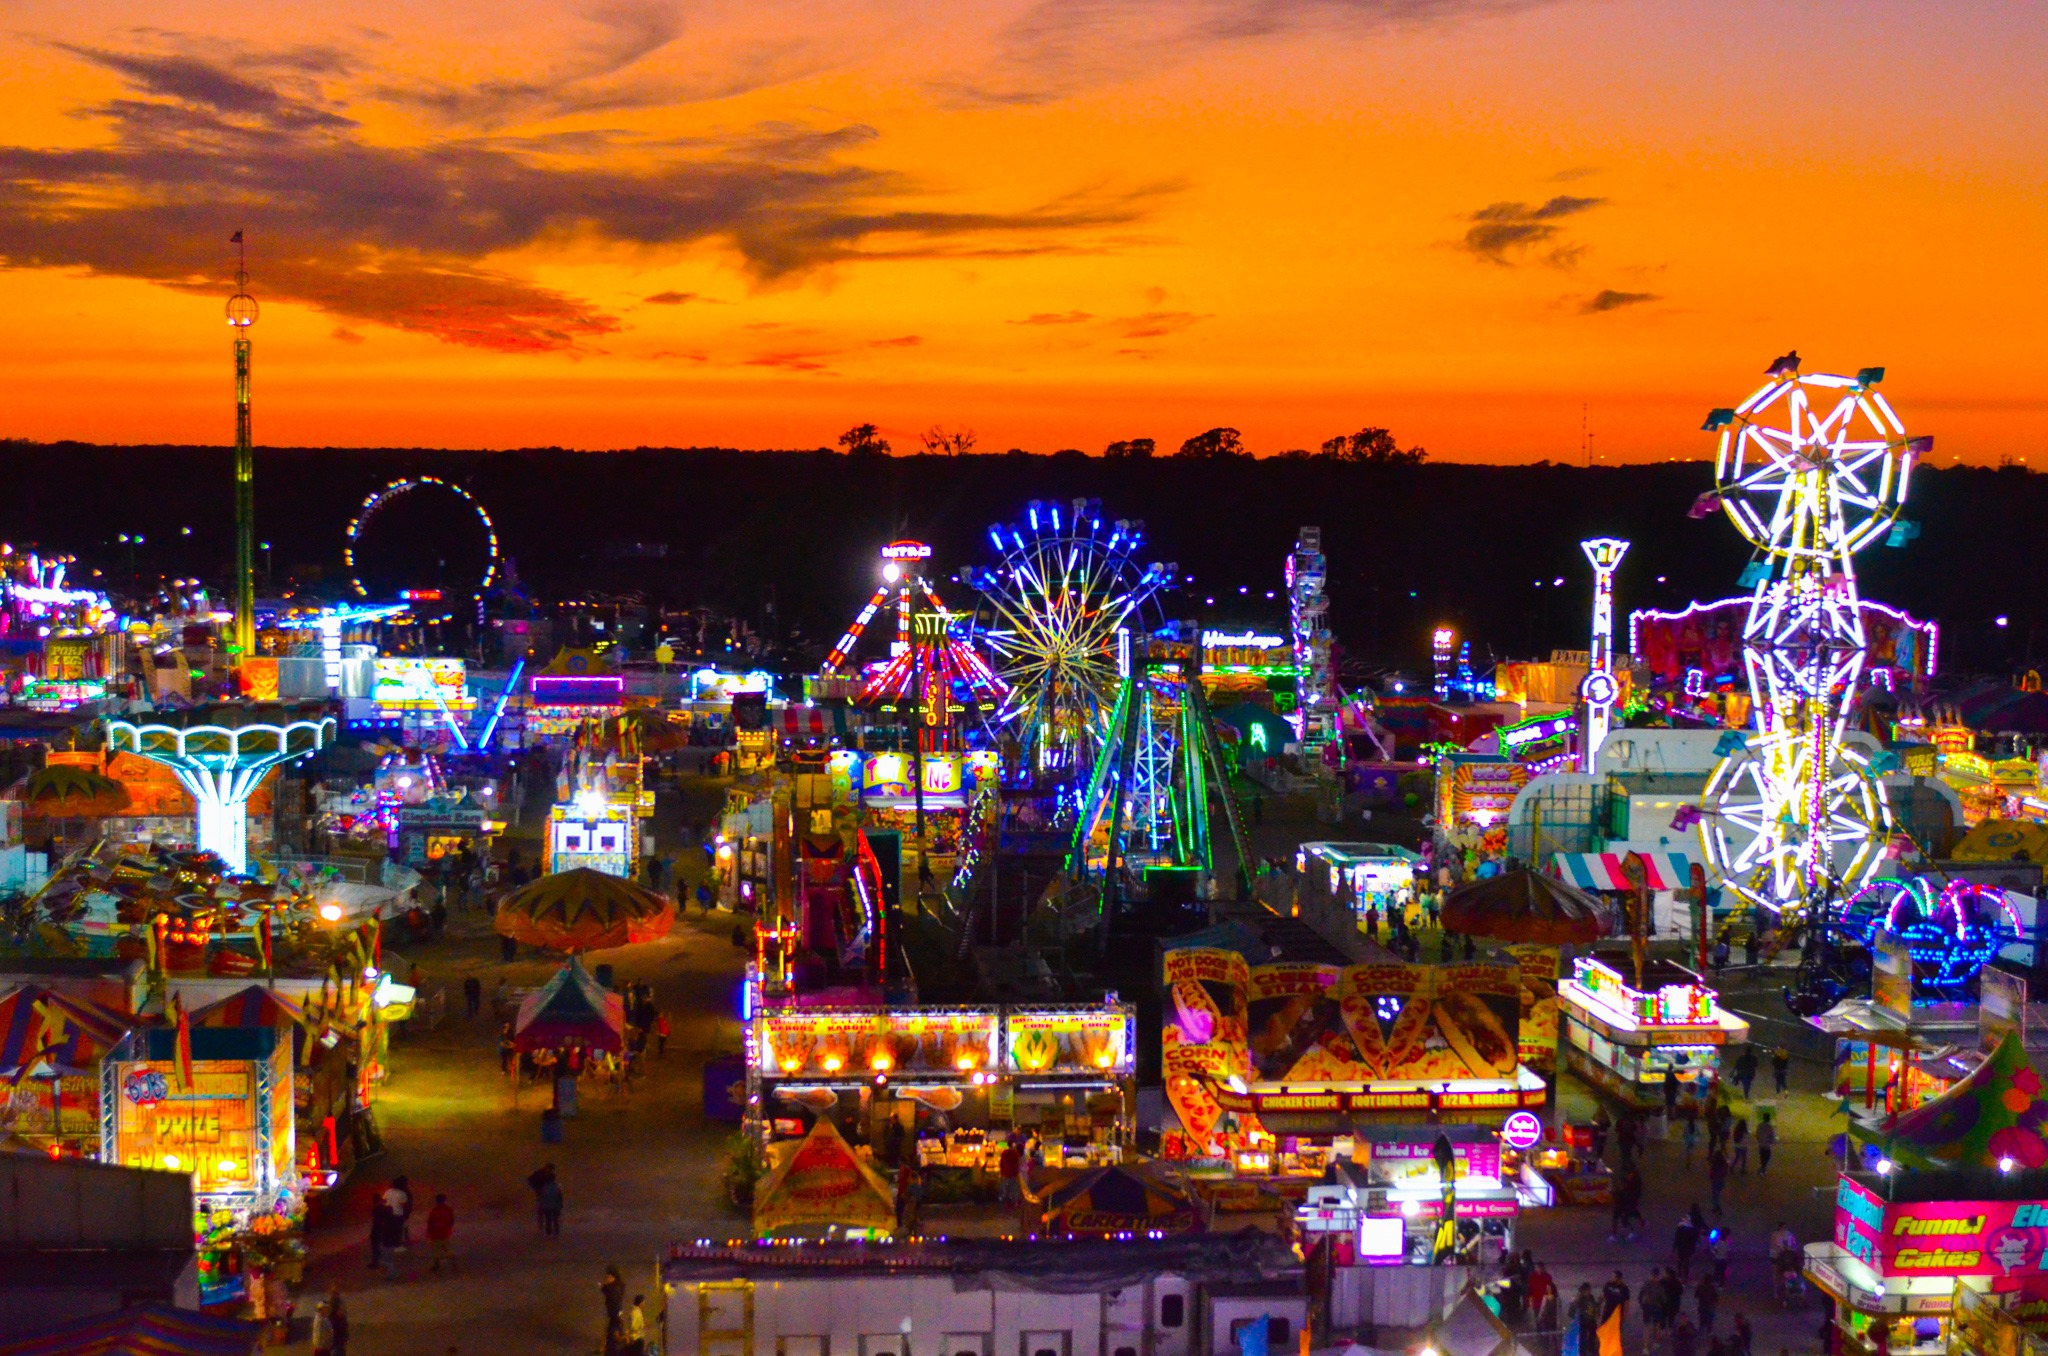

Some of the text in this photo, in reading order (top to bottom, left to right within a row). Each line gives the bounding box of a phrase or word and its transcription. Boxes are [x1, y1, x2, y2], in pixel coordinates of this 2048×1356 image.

[53, 646, 88, 655] PORK
[907, 760, 952, 789] ZNE
[1167, 958, 1190, 970] HOT
[1195, 957, 1228, 970] DOGS
[1171, 969, 1194, 980] AND
[1197, 968, 1226, 981] FRIES
[1353, 970, 1422, 982] CORN
[1357, 982, 1415, 993] DOGS
[1166, 1049, 1226, 1060] CORN
[1169, 1060, 1222, 1074] DOGS
[128, 1072, 167, 1101] BOB'S
[1262, 1095, 1337, 1108] CHICKEN STRIPS
[1351, 1095, 1429, 1106] FOOT LONG DOGS
[1442, 1094, 1457, 1106] 1/2
[1473, 1094, 1517, 1105] BURGERS
[155, 1108, 219, 1144] PRIZE
[1376, 1145, 1429, 1157] Rolled Ice
[1475, 1204, 1487, 1213] Ice
[1488, 1204, 1514, 1213] Cream
[1892, 1215, 1987, 1236] Funnel
[1893, 1247, 1982, 1269] Cakes
